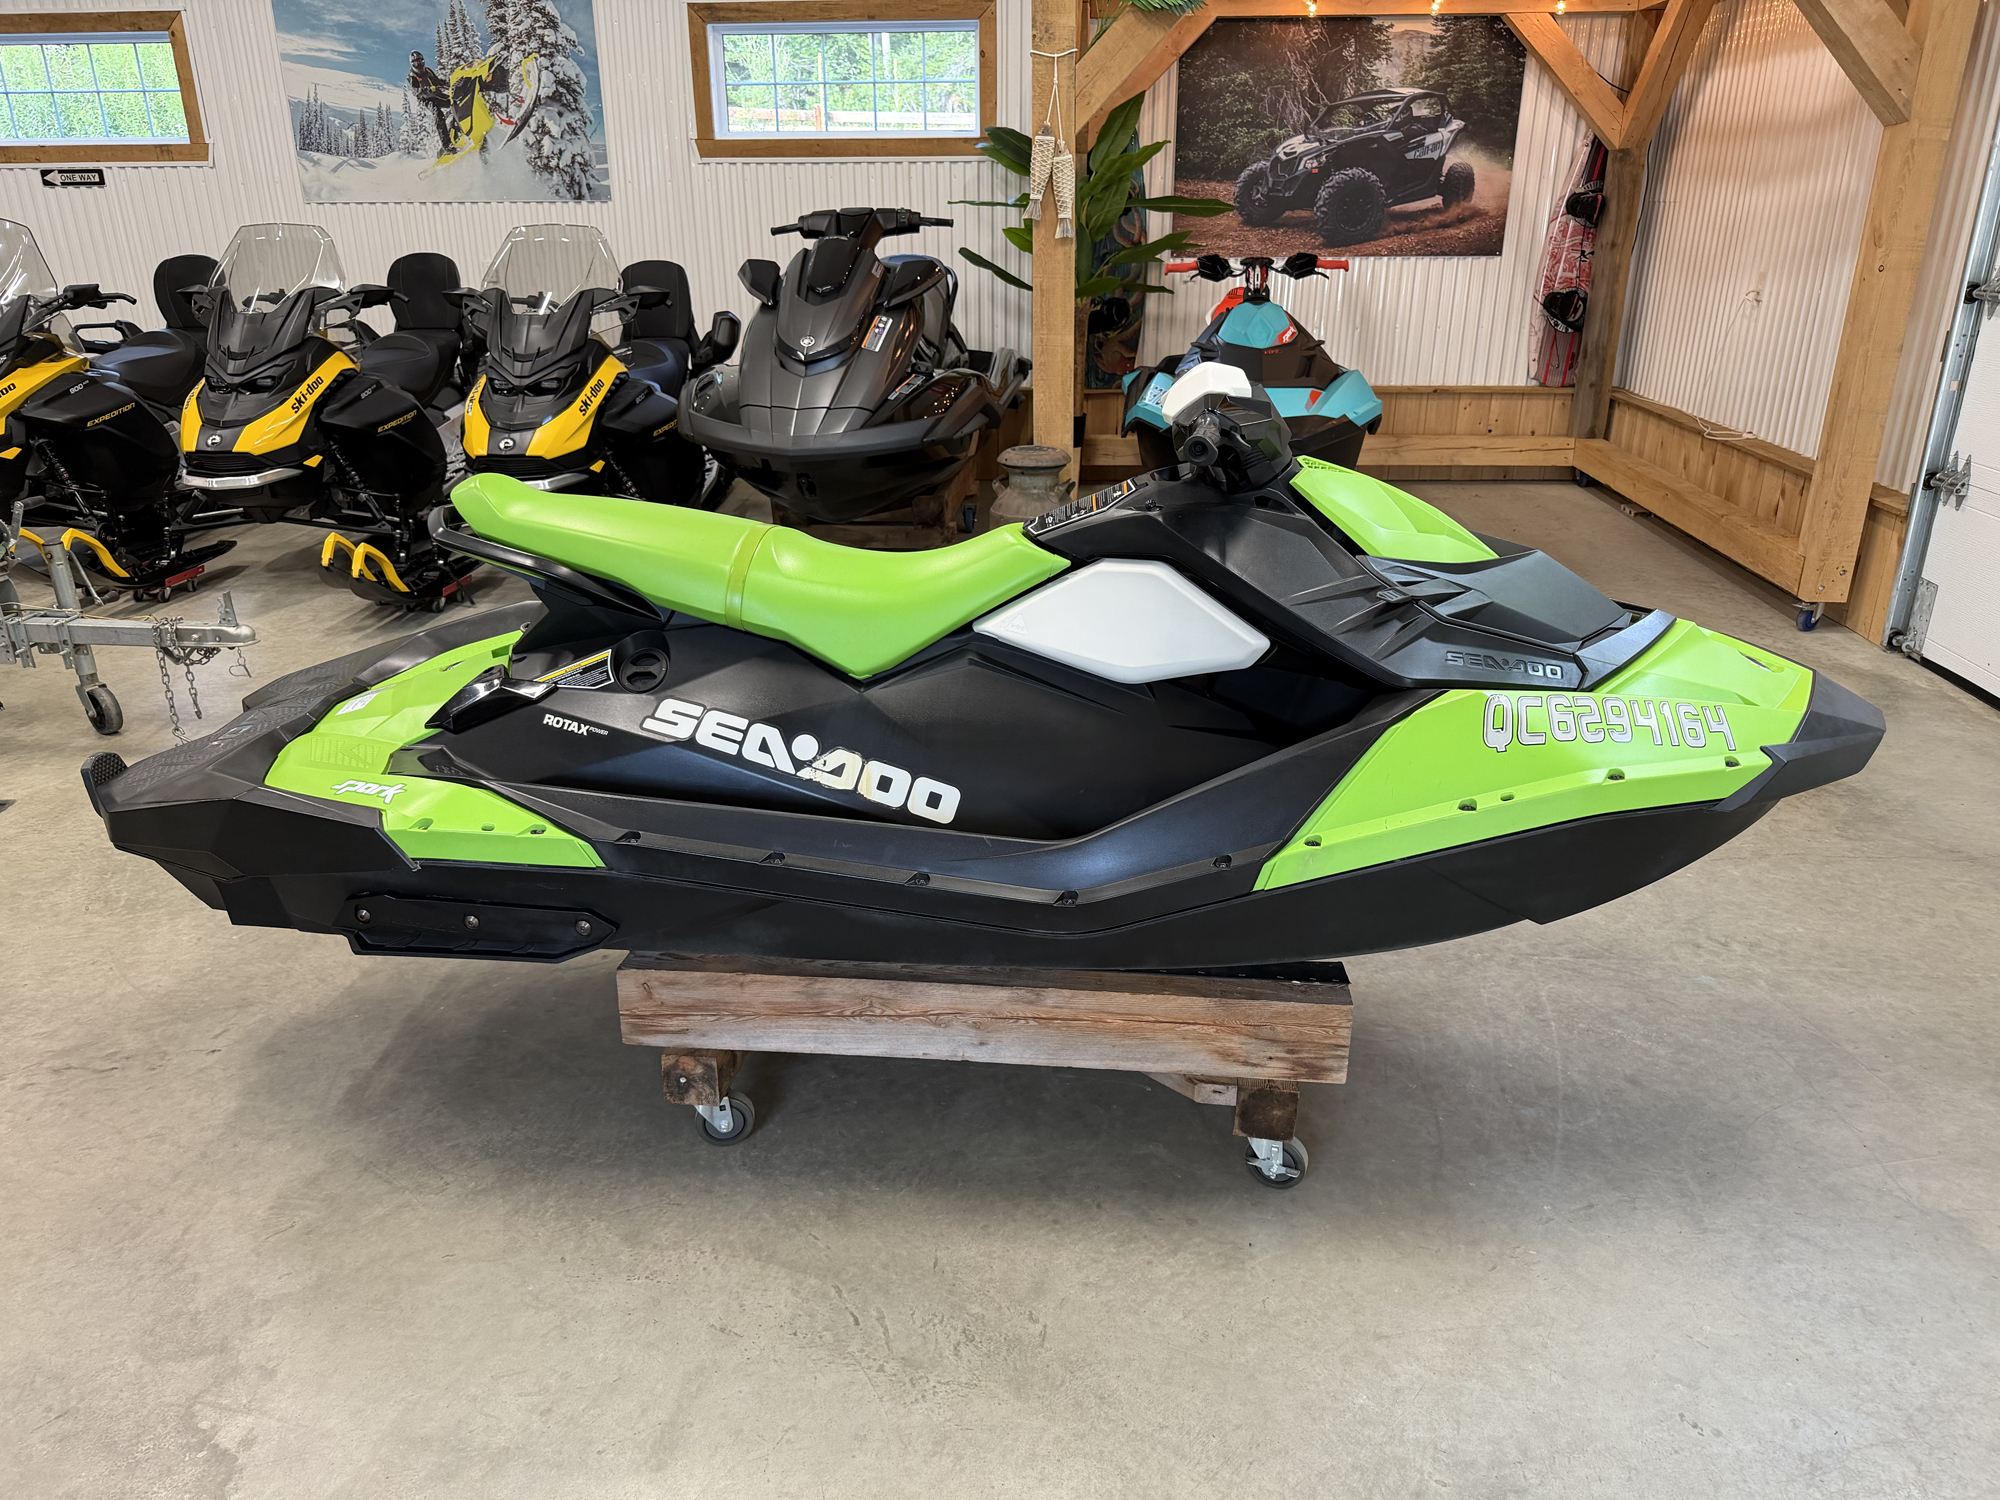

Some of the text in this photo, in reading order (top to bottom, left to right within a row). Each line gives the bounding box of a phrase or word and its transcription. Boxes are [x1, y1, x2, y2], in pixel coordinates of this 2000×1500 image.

[60, 174, 97, 182] ONE WAY
[291, 376, 324, 415] ski-doo
[579, 378, 605, 417] ski-doo
[86, 402, 136, 427] EXPEDITION
[543, 713, 609, 736] ROTAX POWER
[1483, 693, 1736, 753] QC6294164
